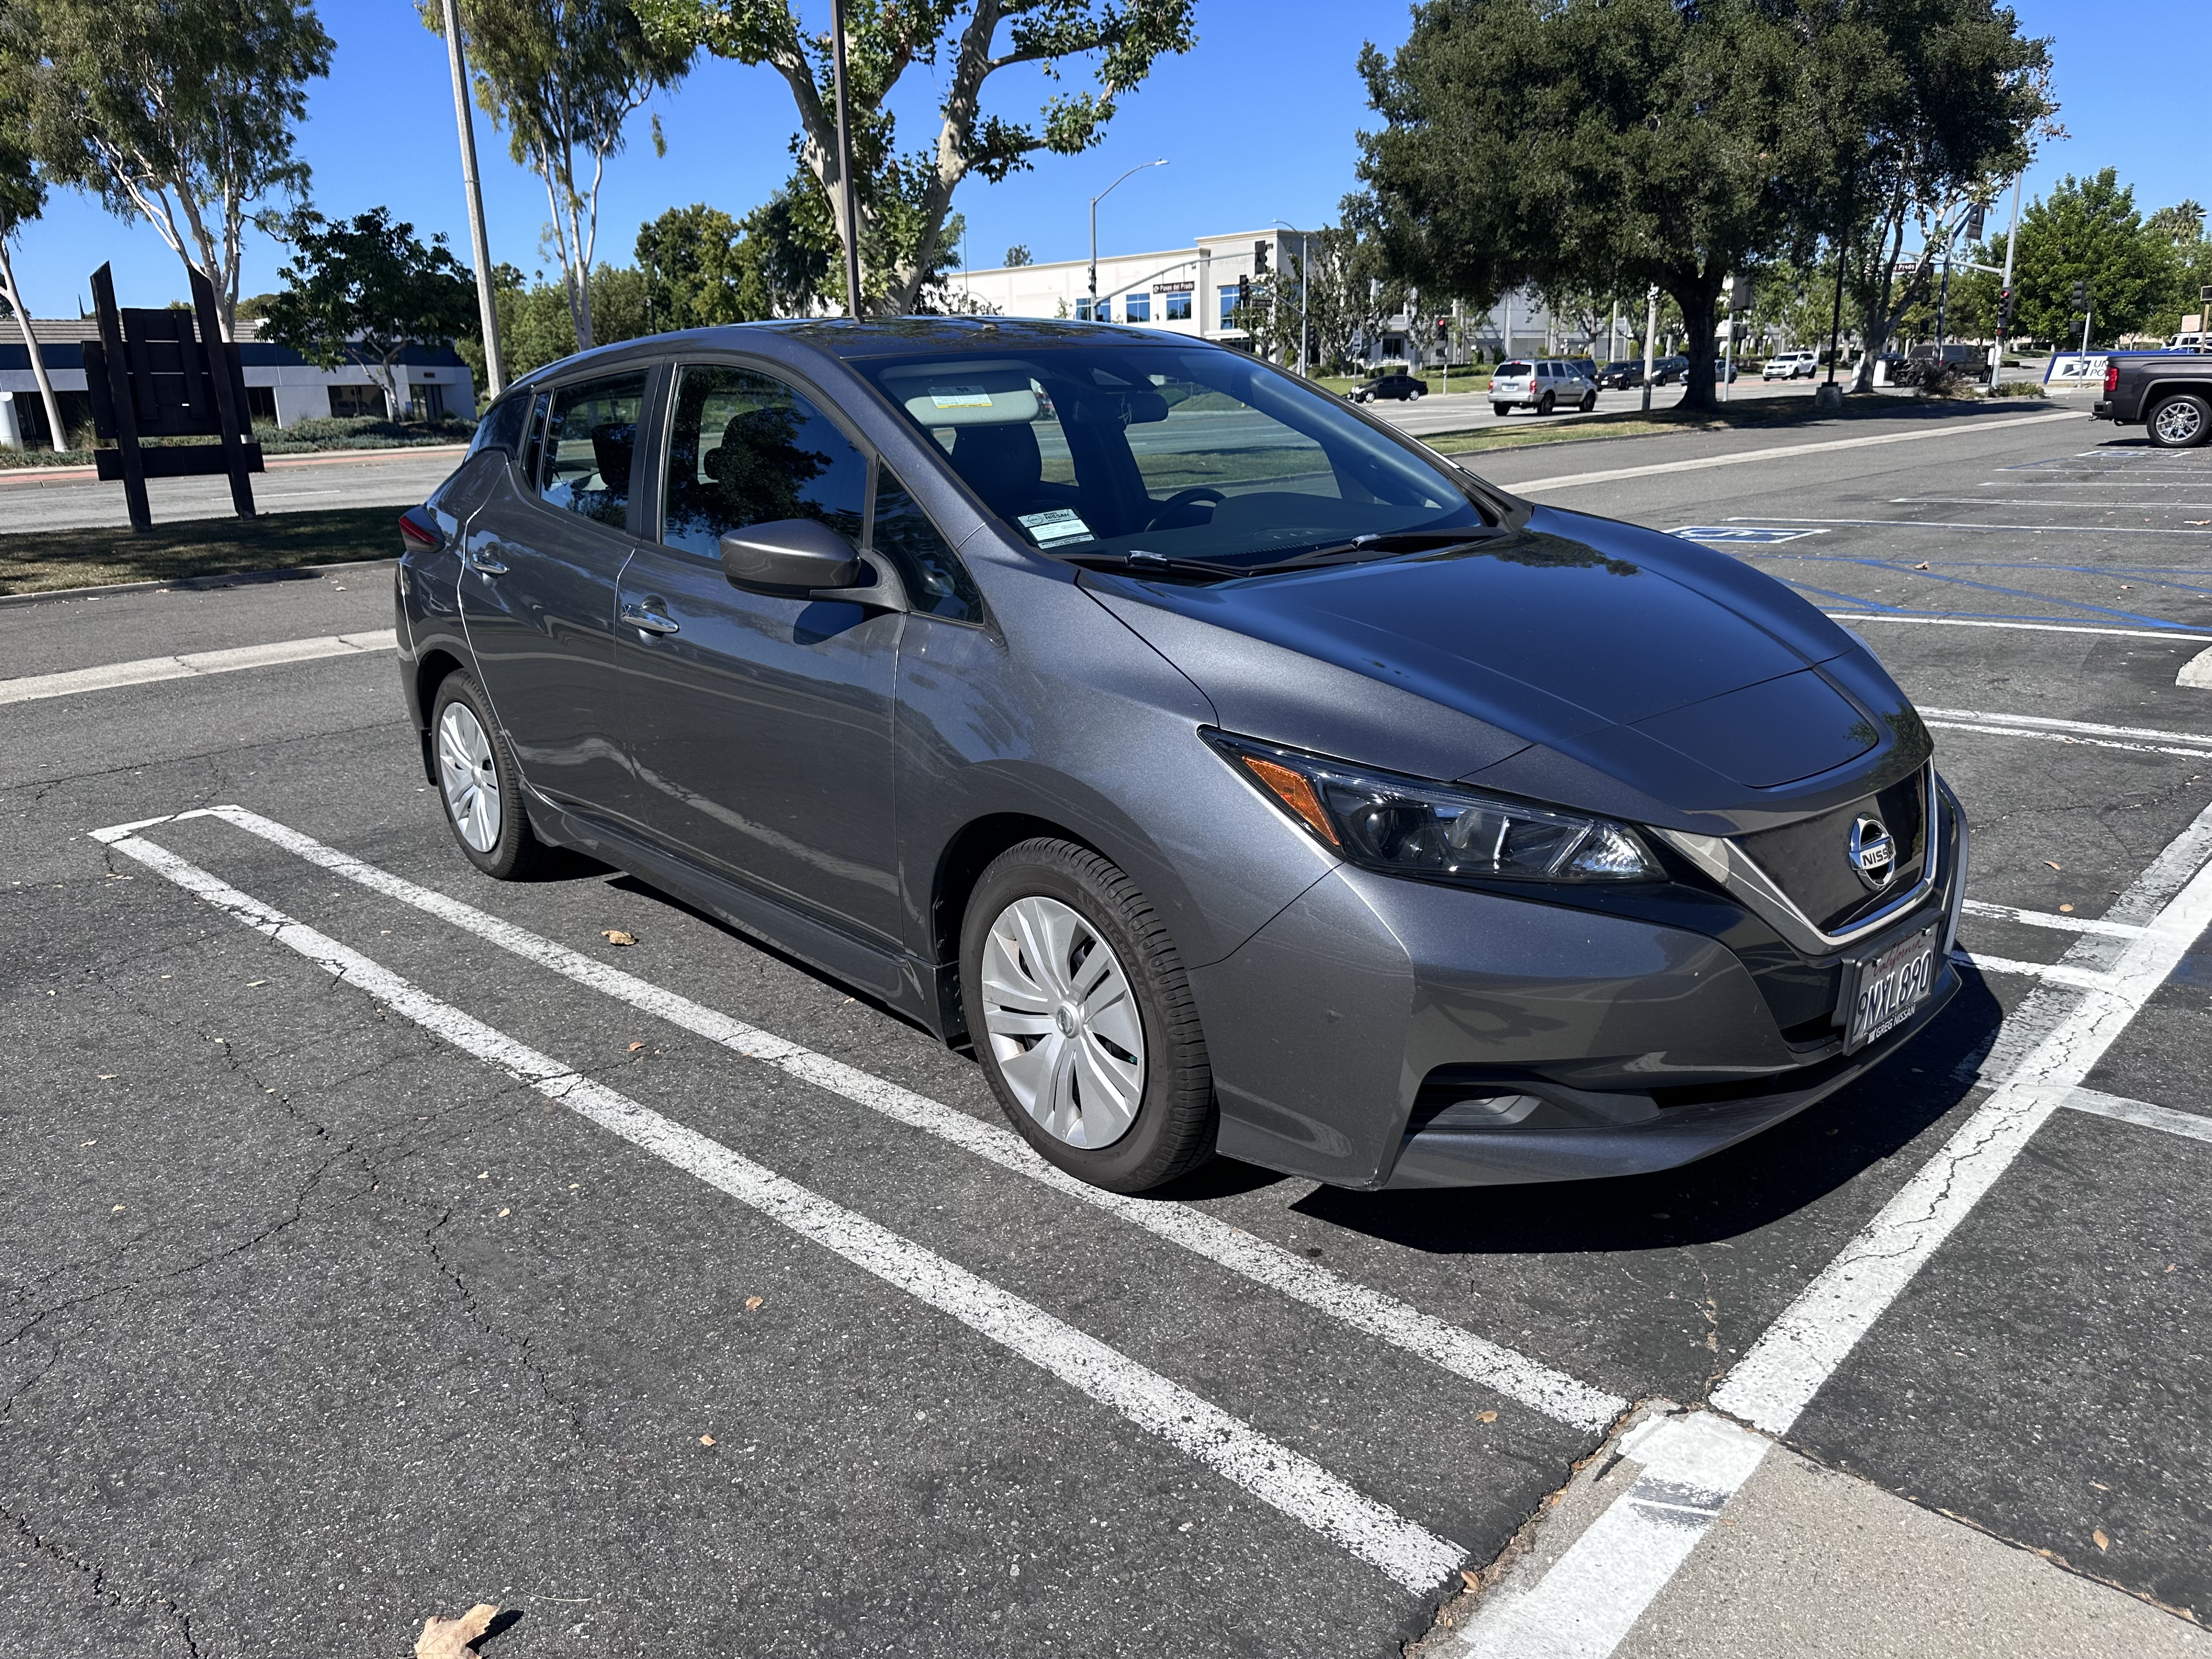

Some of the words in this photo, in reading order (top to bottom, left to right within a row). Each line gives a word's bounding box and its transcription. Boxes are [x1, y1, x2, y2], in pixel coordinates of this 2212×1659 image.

[1862, 845, 1894, 866] NISSA
[1098, 912, 1148, 997] MICHELIN
[1873, 938, 1924, 977] California
[1893, 1003, 1916, 1026] NISSAN
